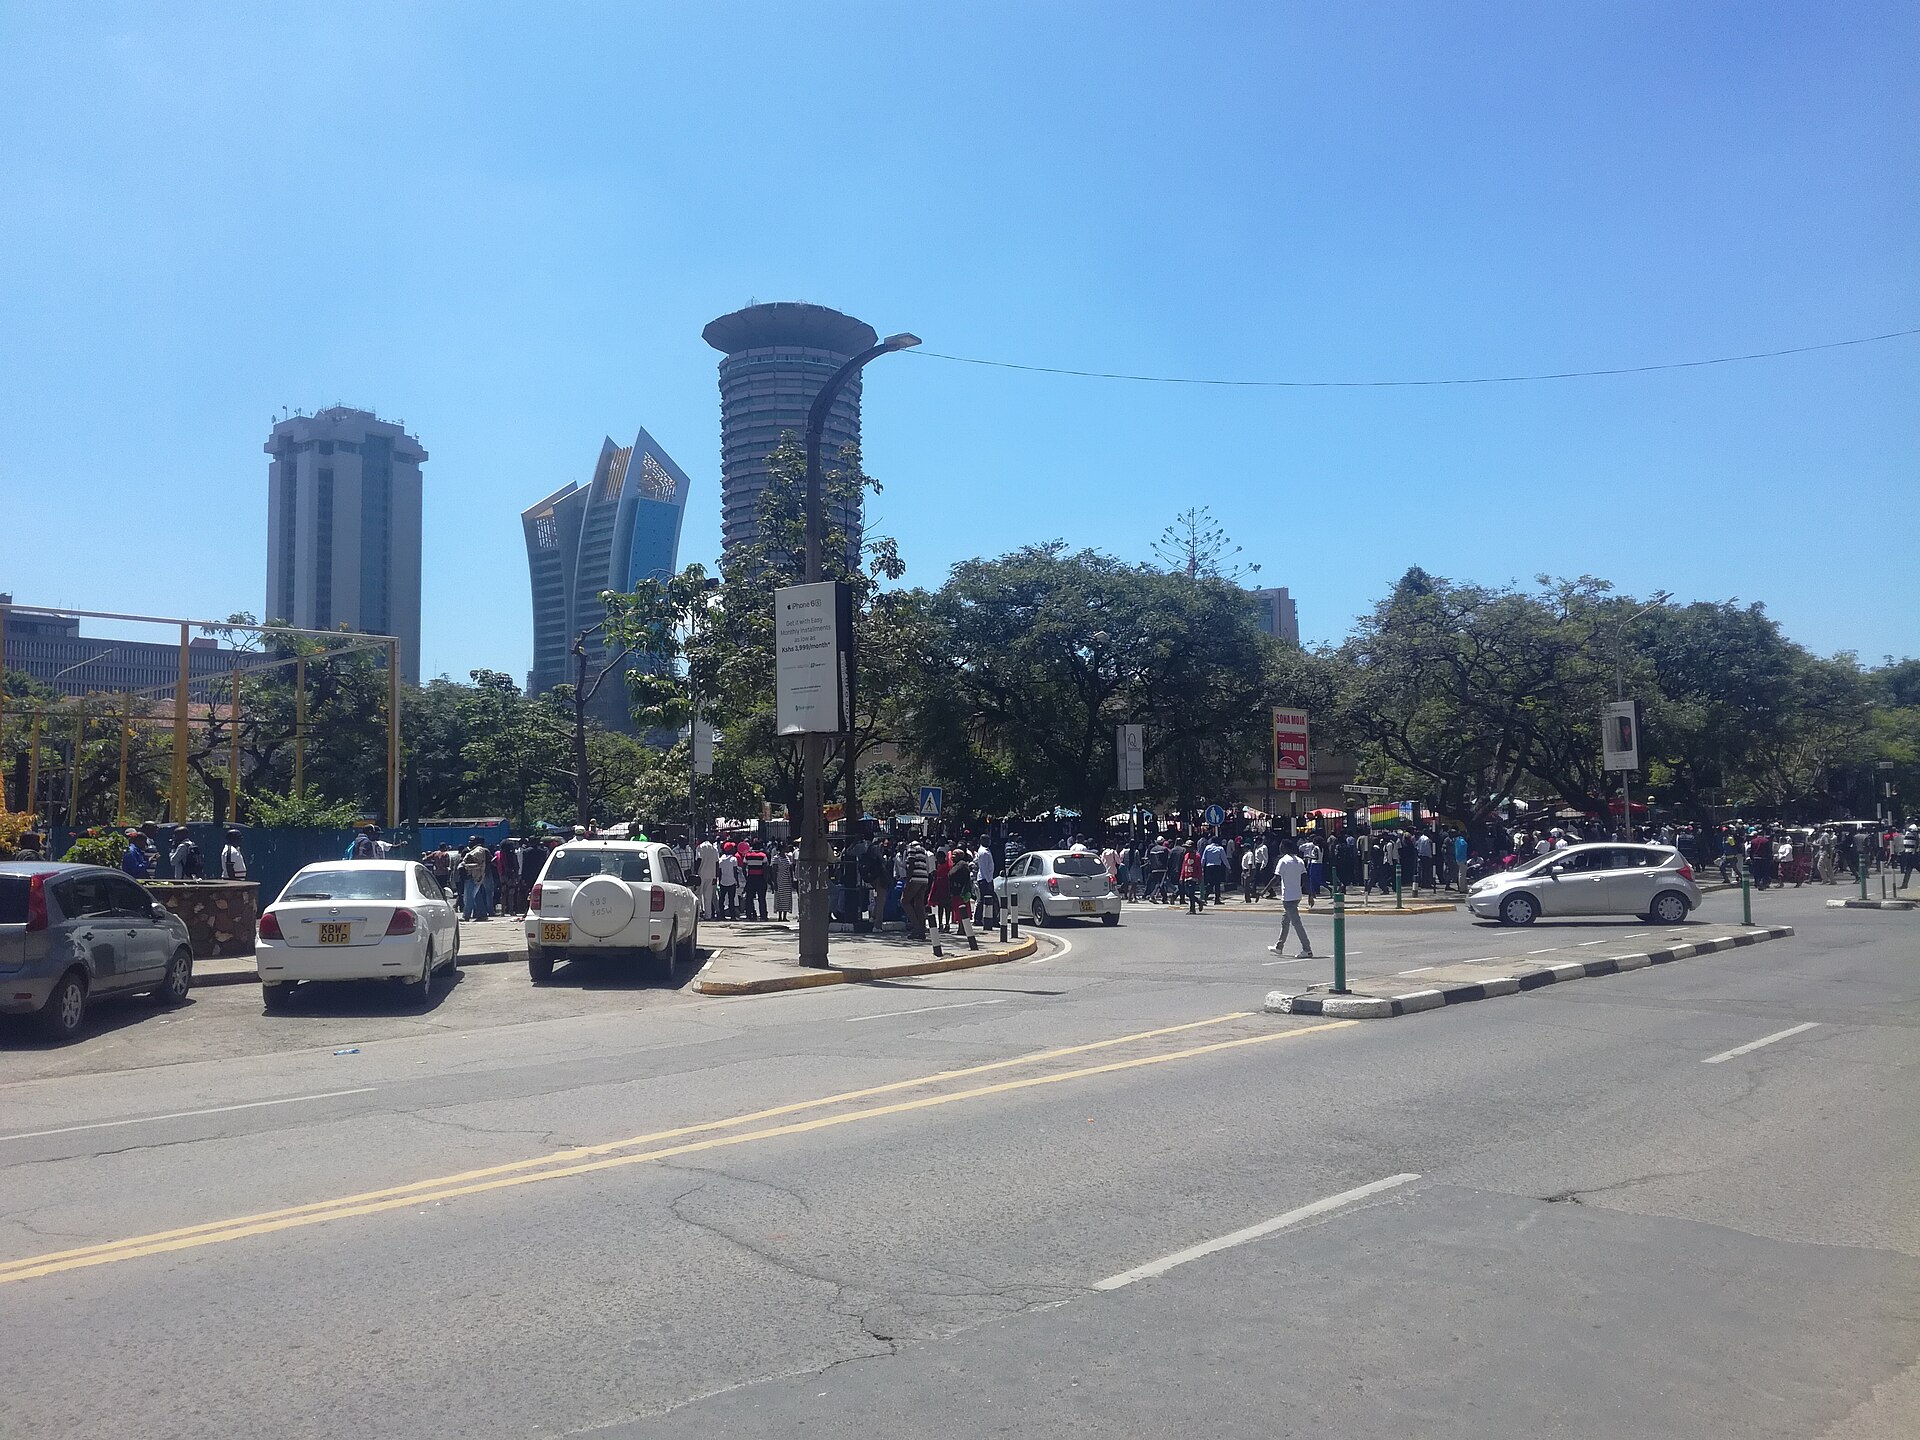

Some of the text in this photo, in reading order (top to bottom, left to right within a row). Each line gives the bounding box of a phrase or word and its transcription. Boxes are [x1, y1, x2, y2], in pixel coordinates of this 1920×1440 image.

[791, 601, 810, 609] iPhone
[780, 628, 800, 636] Monthly
[590, 895, 606, 906] KBS
[591, 906, 613, 916] 365W
[321, 924, 342, 933] KBW
[320, 933, 348, 942] 601P
[544, 931, 567, 940] 365W
